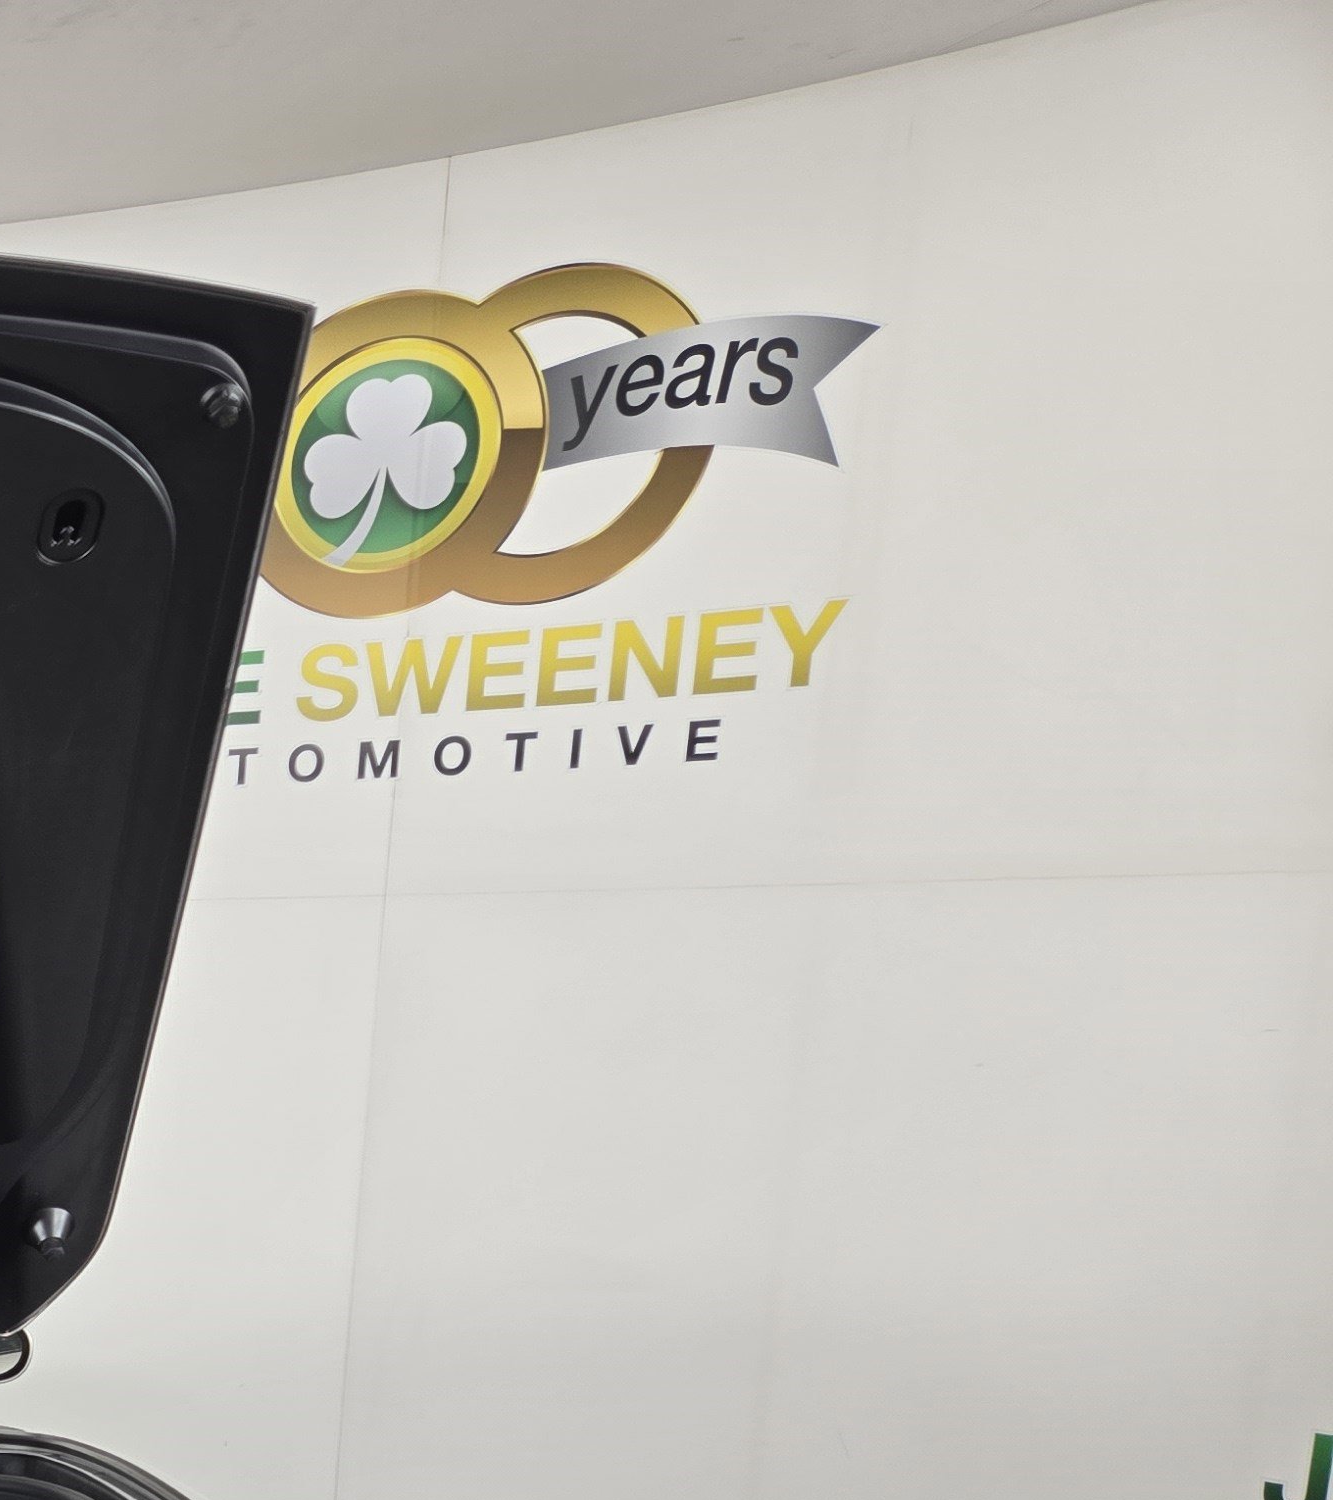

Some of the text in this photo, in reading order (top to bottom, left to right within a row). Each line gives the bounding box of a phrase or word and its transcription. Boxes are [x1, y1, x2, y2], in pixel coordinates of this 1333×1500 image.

[259, 262, 715, 619] 00
[563, 337, 799, 452] years
[295, 598, 850, 723] SWEENEY
[228, 719, 722, 786] TOMOTIVE
